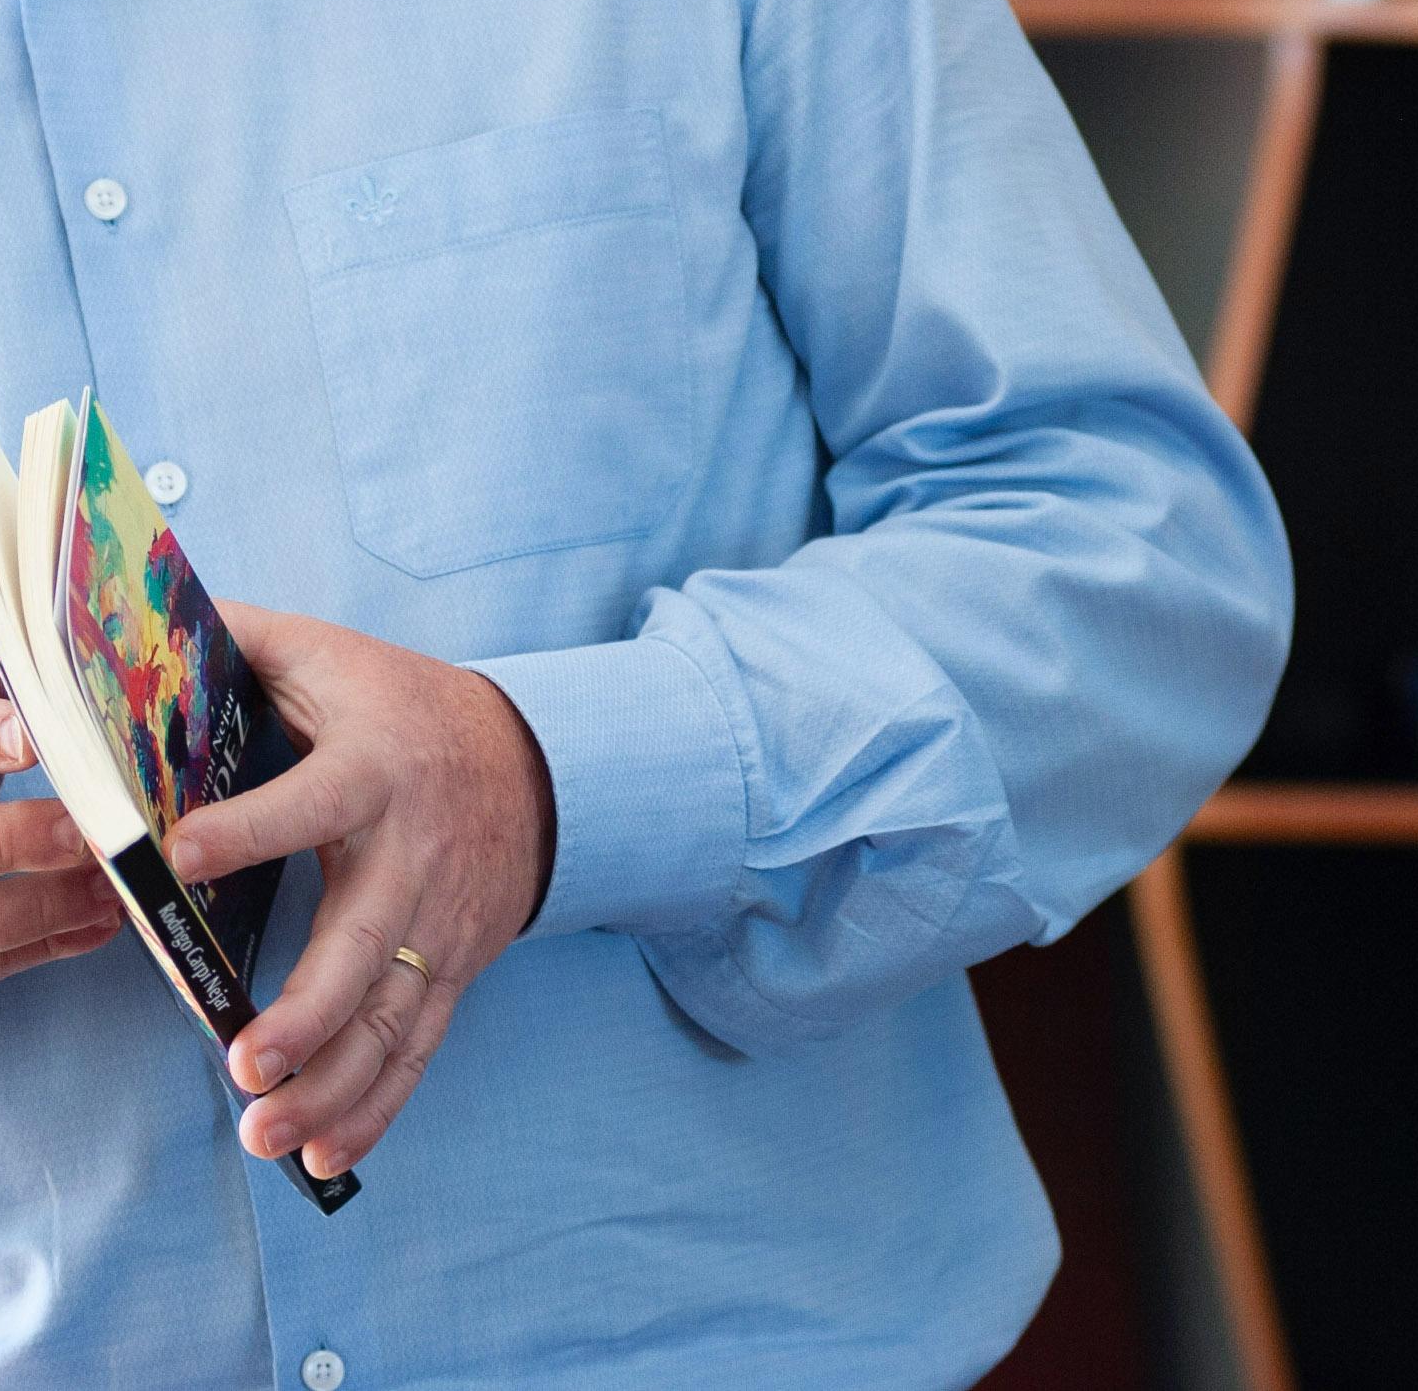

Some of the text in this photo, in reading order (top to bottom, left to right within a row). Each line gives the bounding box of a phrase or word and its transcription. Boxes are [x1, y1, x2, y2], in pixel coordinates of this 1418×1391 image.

[212, 688, 234, 753] Nejar
[158, 901, 231, 1011] Rodrigo Carpi Nejar
